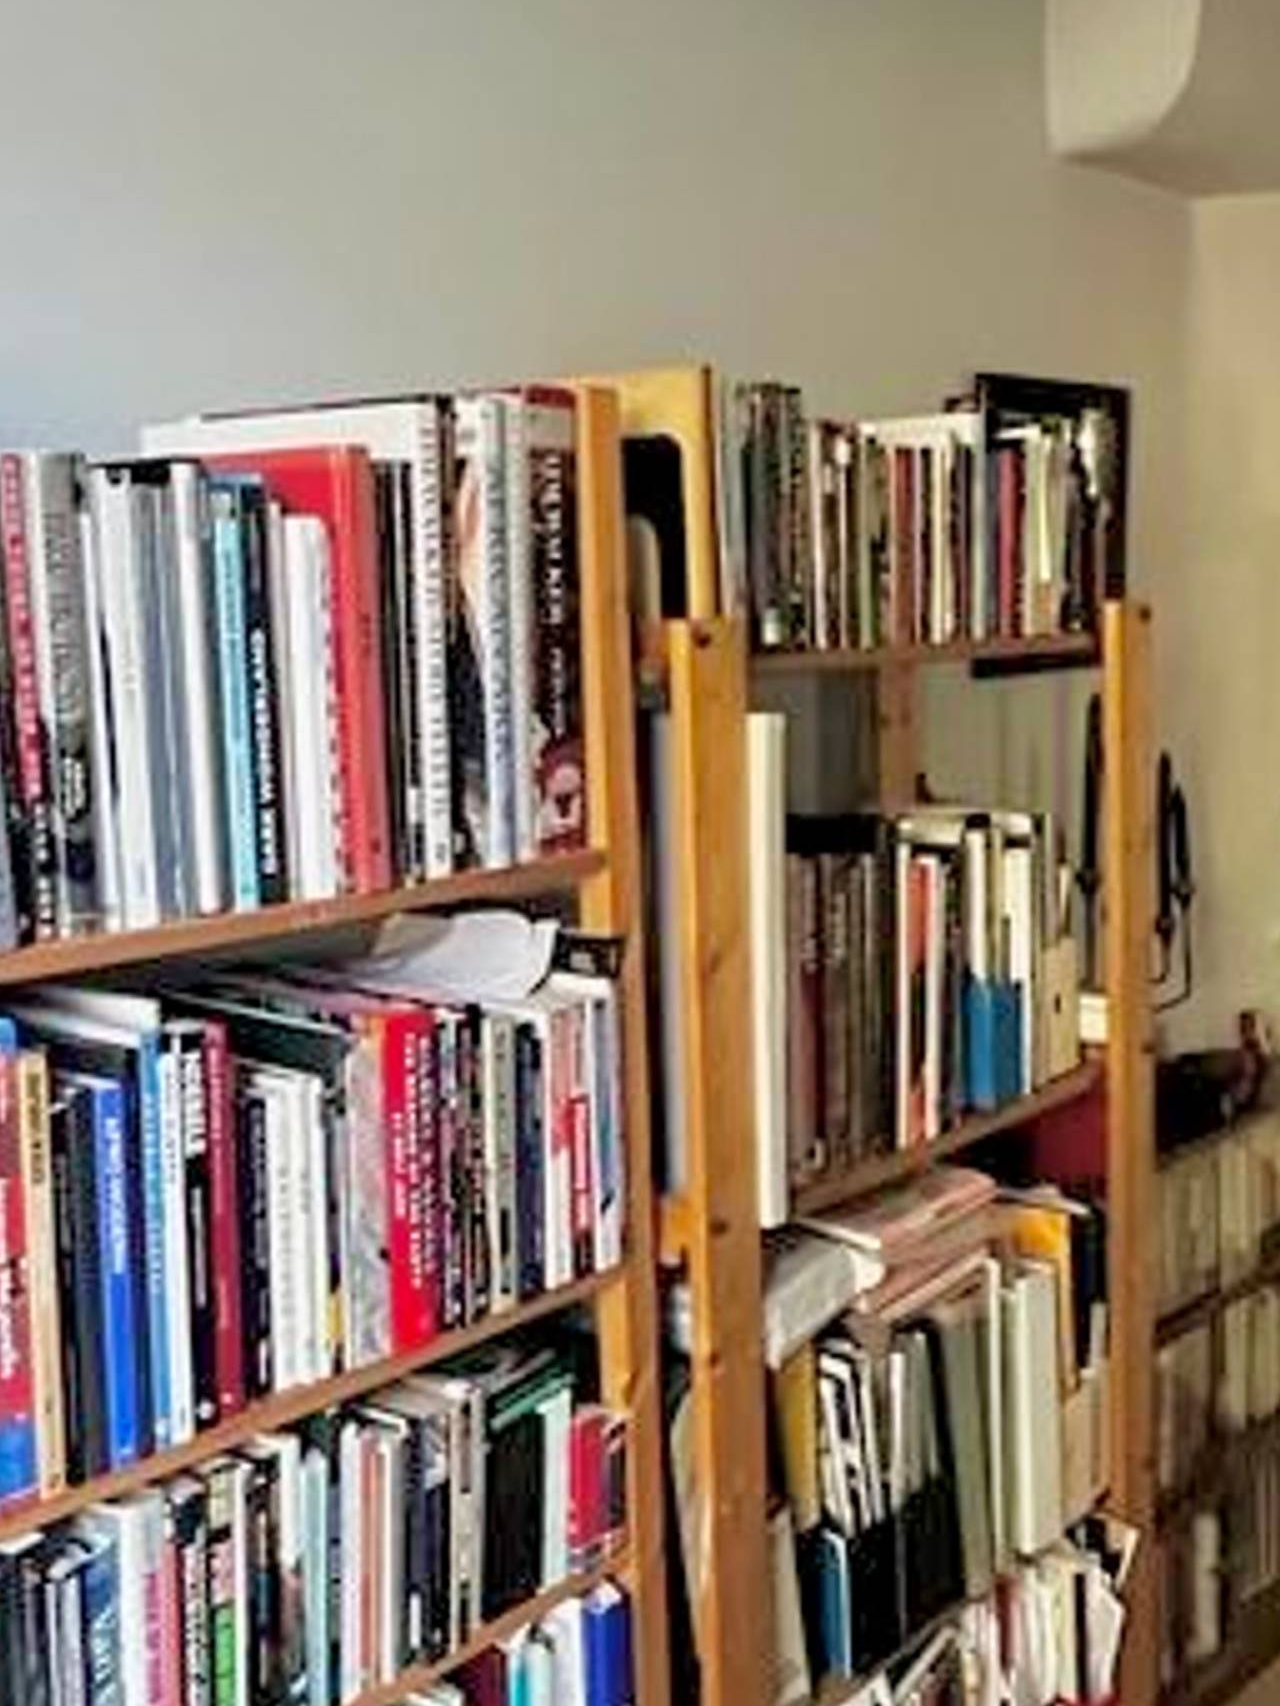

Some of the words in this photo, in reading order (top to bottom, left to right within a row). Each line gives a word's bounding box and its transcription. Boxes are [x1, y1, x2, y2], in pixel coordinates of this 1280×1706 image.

[543, 508, 564, 624] WALKER
[250, 628, 273, 805] WONDERLAND
[91, 1608, 117, 1679] Van
